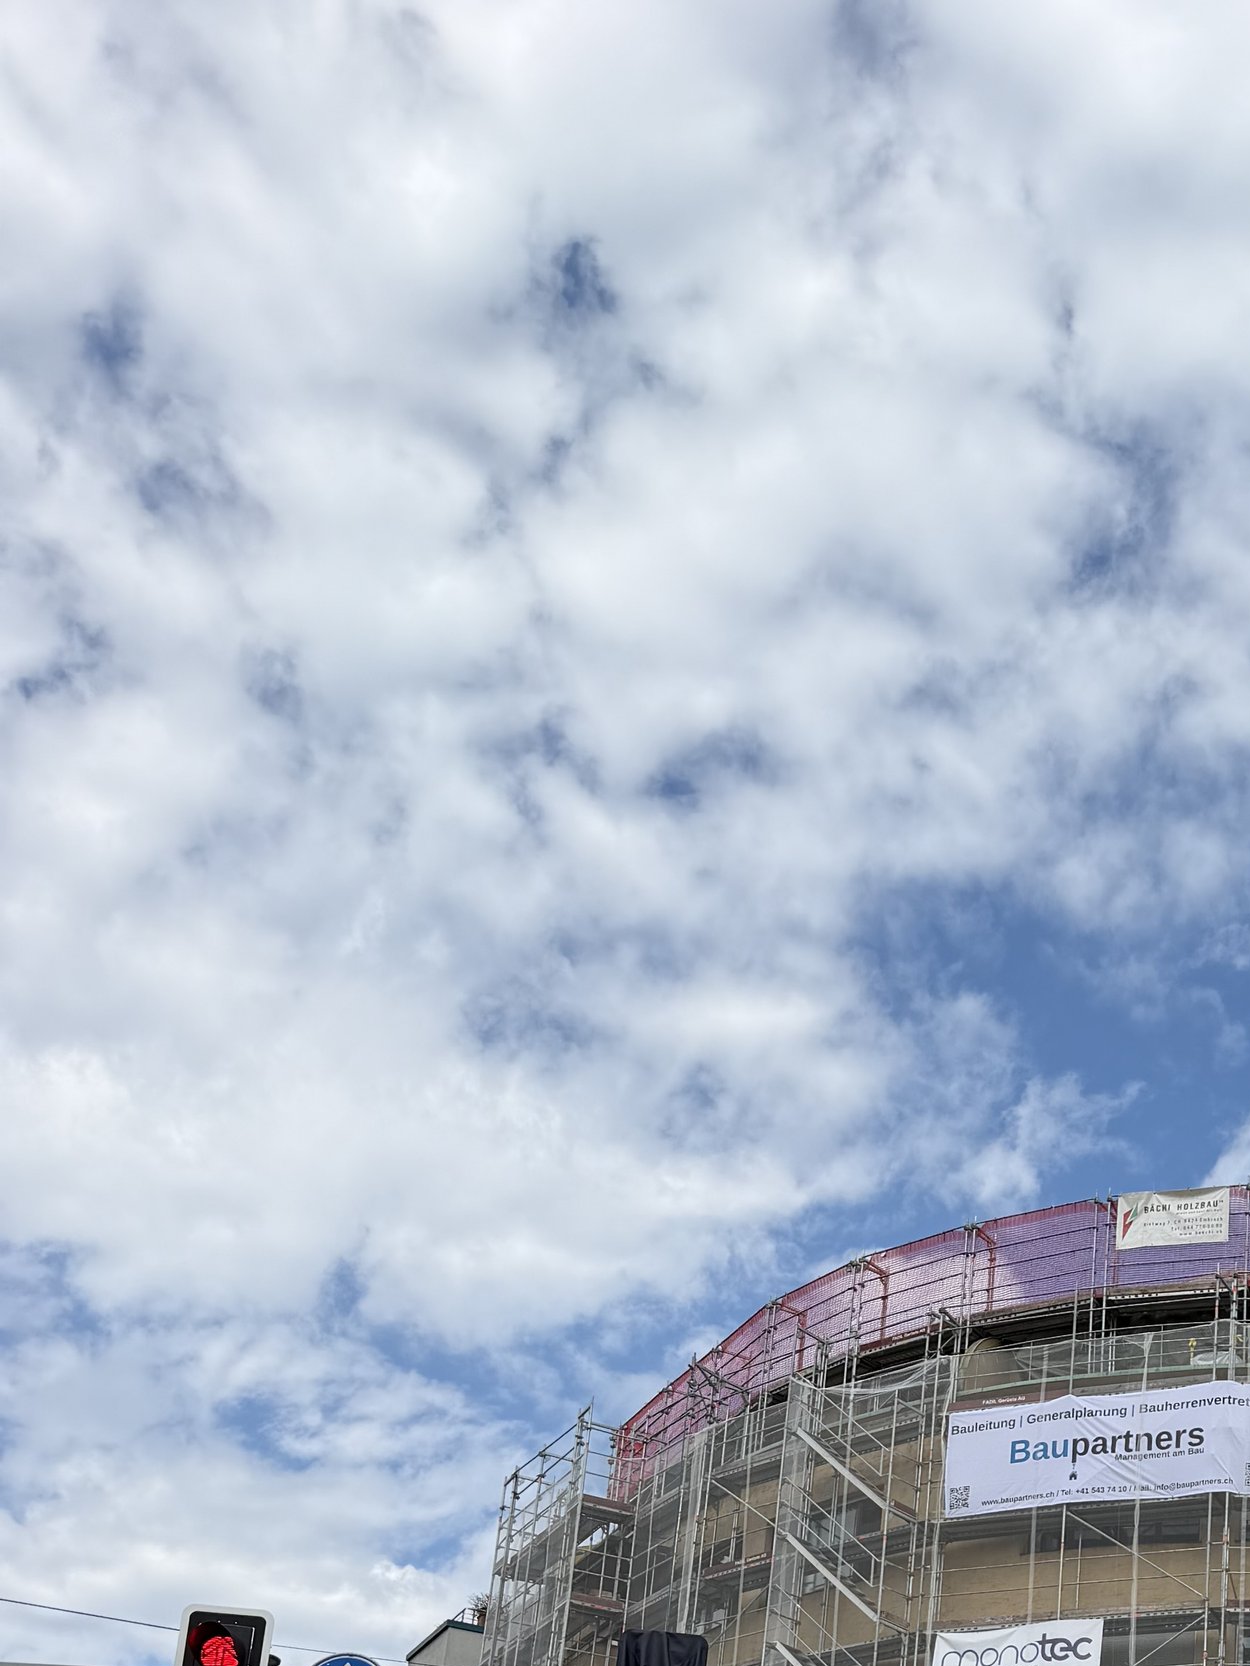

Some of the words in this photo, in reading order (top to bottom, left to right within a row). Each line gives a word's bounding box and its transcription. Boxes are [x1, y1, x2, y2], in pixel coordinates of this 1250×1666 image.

[1177, 1201, 1218, 1211] HOLZBAU
[951, 1418, 1016, 1435] Bauleitung
[1027, 1407, 1127, 1424] Generalplanung
[1010, 1427, 1204, 1463] Baupartners
[1114, 1452, 1170, 1461] Management
[1188, 1448, 1204, 1456] Bau
[981, 1492, 1055, 1507] www.baupartners.ch
[1154, 1478, 1233, 1491] info@baupartners.ch
